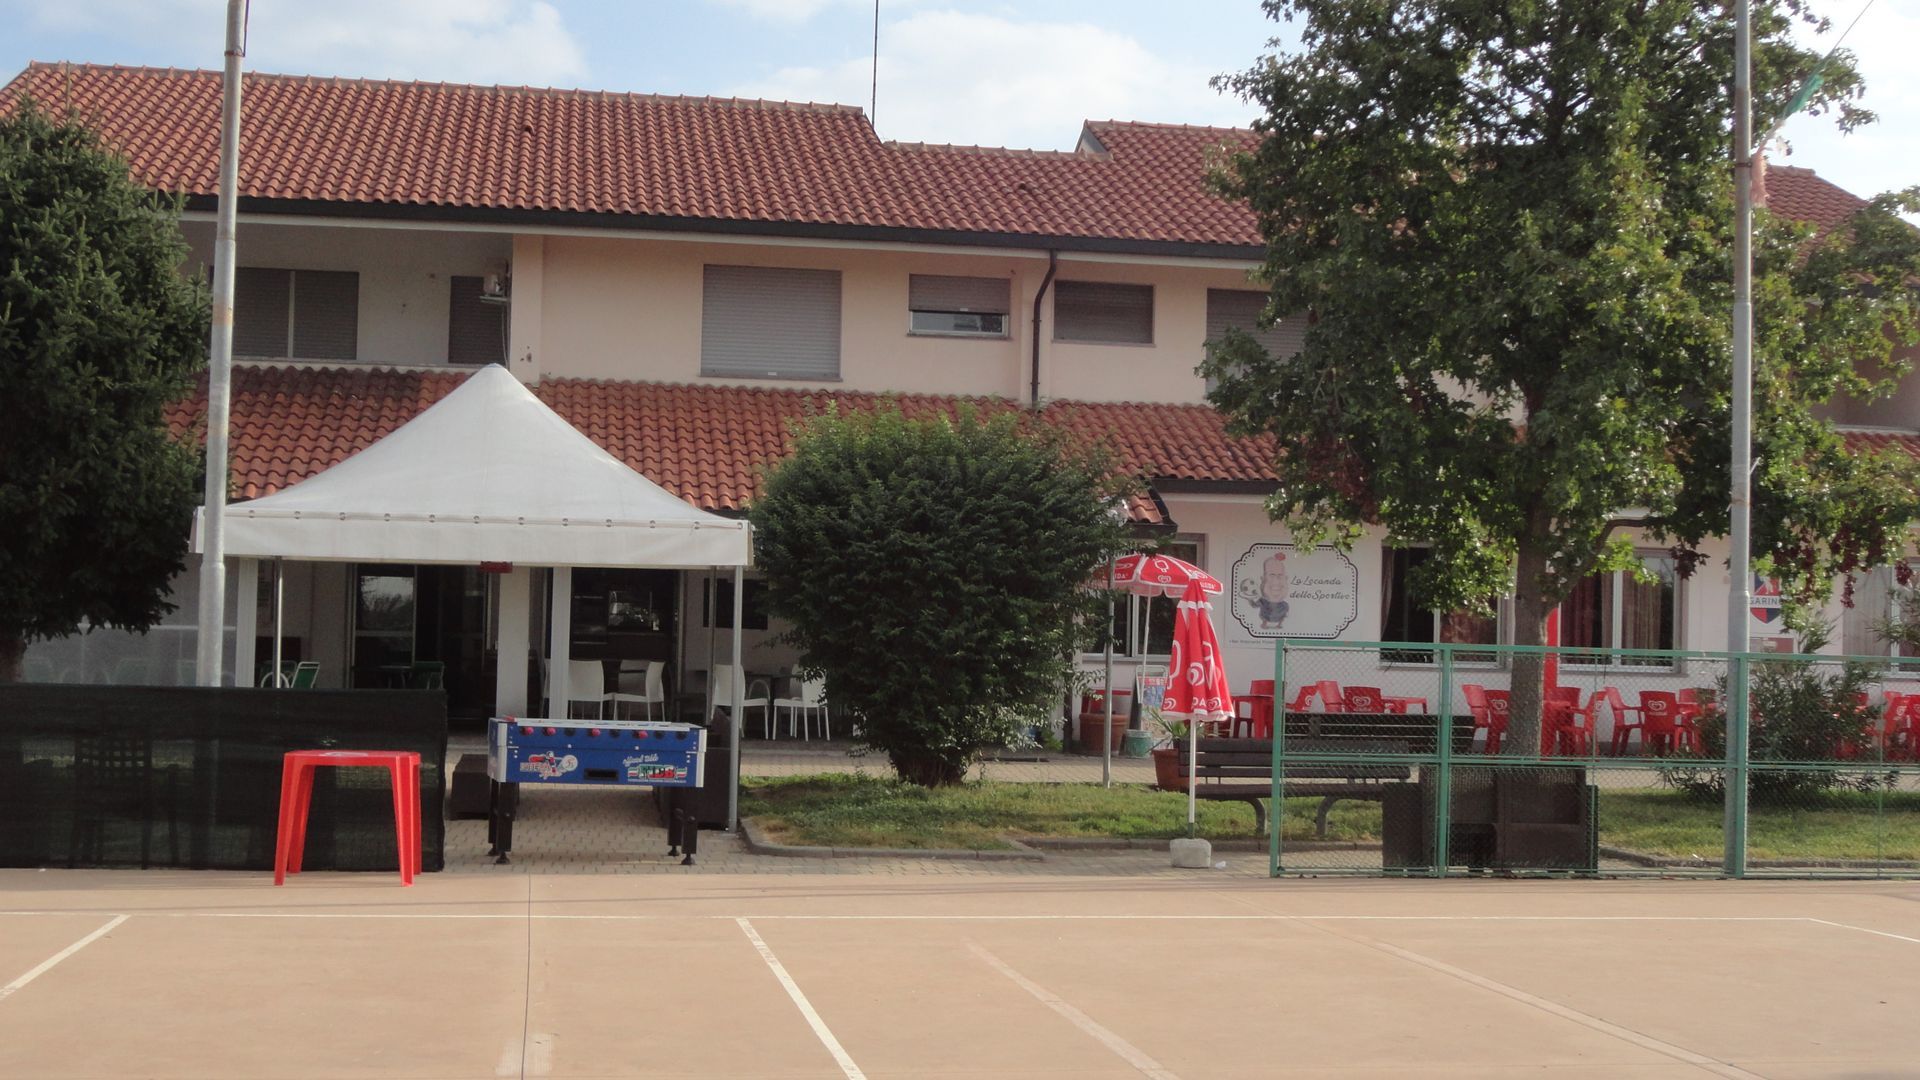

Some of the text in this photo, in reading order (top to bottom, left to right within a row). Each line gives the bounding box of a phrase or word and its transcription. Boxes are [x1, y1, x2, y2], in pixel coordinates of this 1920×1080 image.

[1290, 575, 1343, 586] La Locanda
[1289, 589, 1351, 602] dello Sportivo
